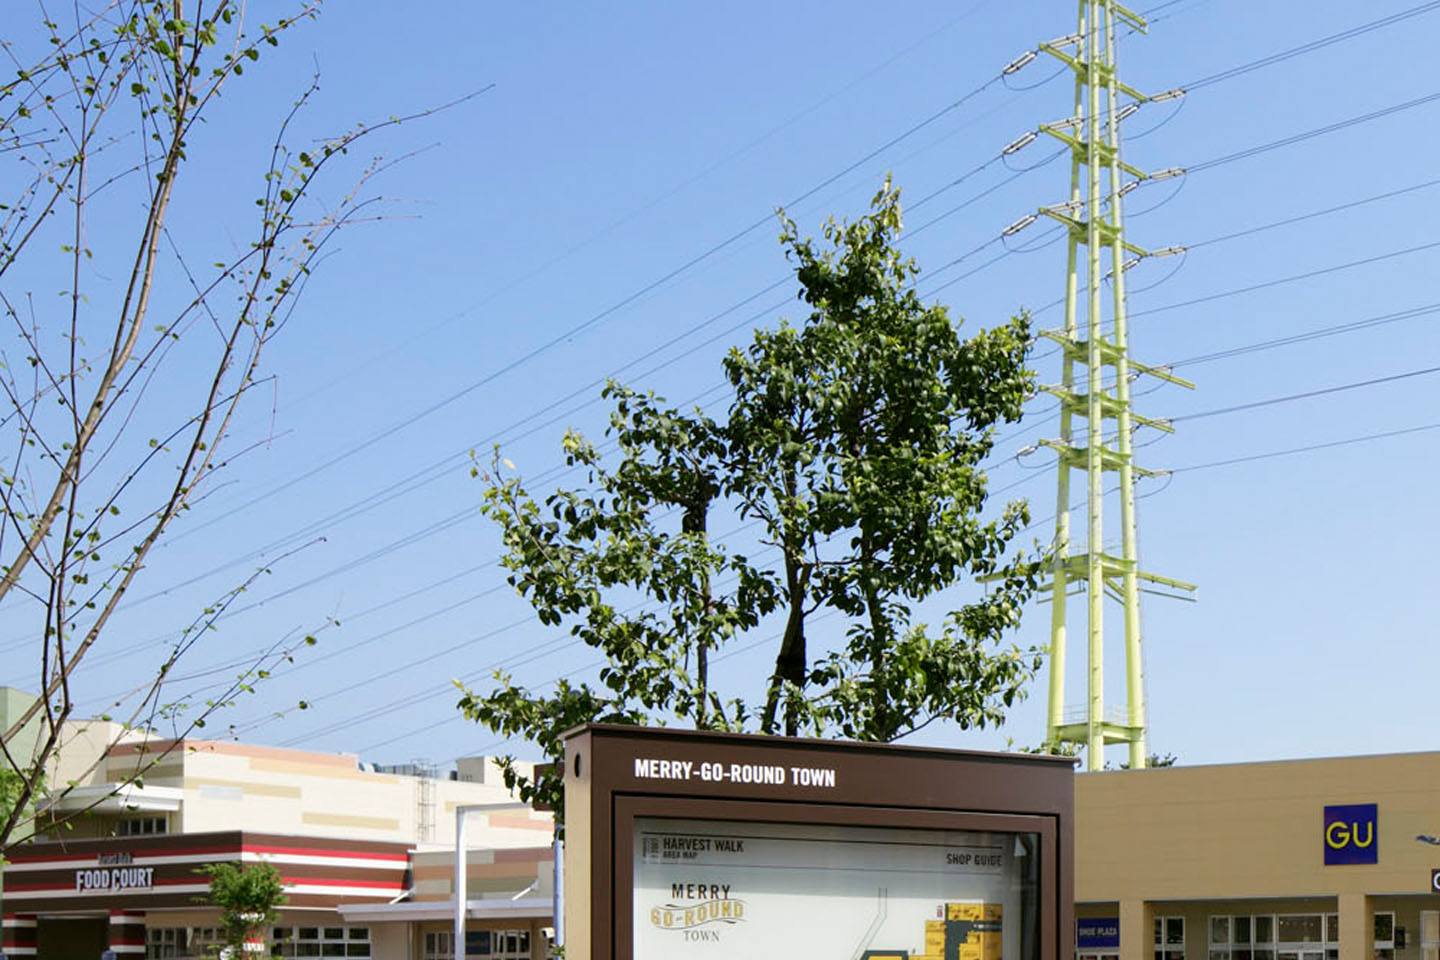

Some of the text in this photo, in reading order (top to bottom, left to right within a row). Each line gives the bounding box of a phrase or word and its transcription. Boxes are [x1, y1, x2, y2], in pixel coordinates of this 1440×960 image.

[634, 759, 836, 787] MERRY-GO-ROUND TOWN
[1325, 821, 1373, 849] GU
[663, 837, 711, 852] HARVEST
[715, 840, 744, 853] WALK
[946, 853, 1003, 866] SHOP GUIDE
[76, 868, 154, 892] FOOD COURT
[671, 883, 731, 900] MERRY
[650, 901, 744, 928] GO-ROUND
[683, 930, 720, 942] TOWN
[1098, 927, 1117, 936] PLAZA
